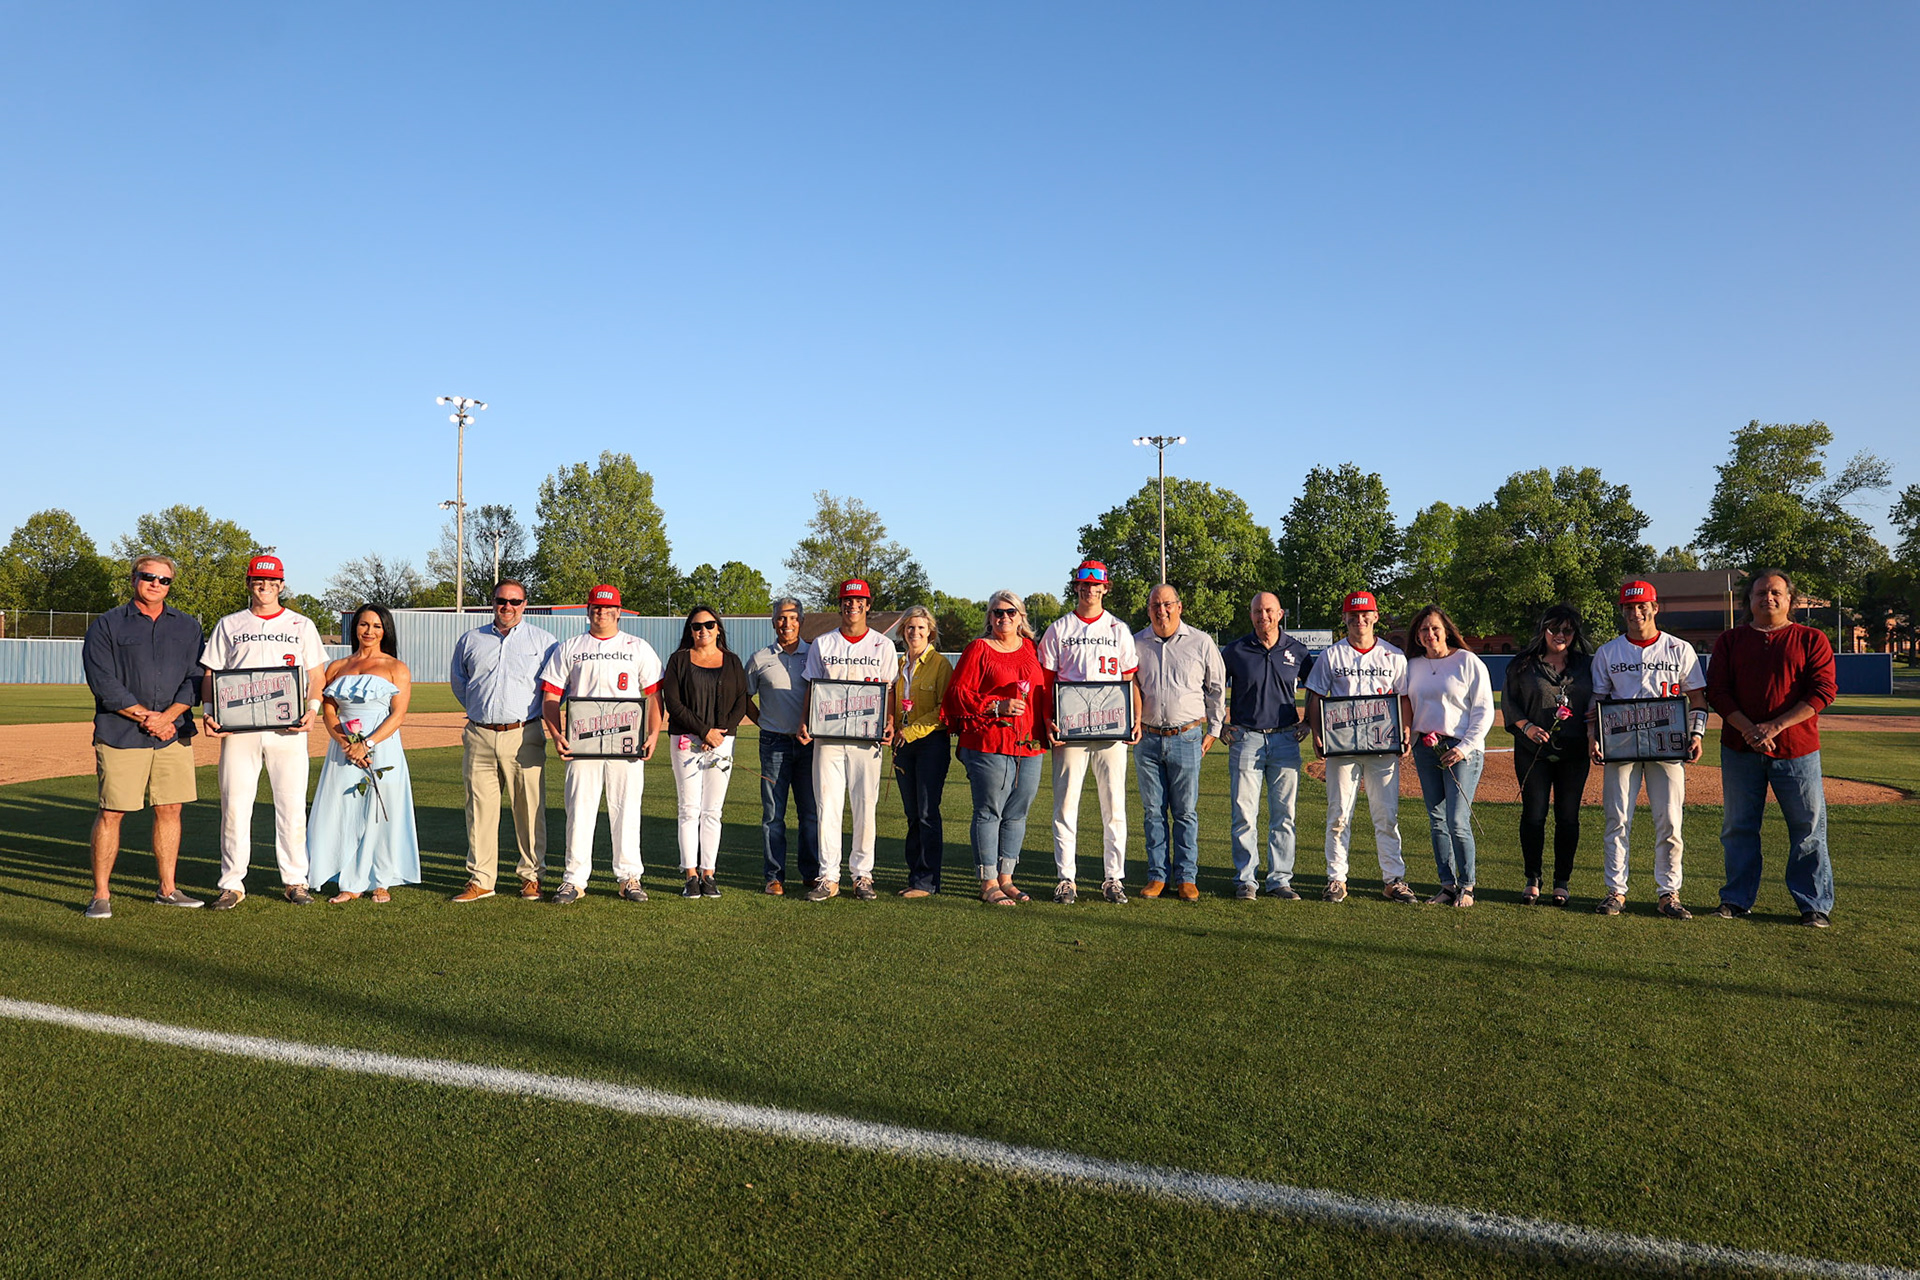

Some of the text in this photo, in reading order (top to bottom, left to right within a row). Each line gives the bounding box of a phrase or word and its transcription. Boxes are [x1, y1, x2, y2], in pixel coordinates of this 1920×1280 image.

[256, 562, 276, 570] SBA
[1625, 587, 1644, 596] SBA
[1099, 655, 1119, 675] 13
[617, 672, 629, 691] 8
[242, 693, 272, 705] EAGLES
[275, 701, 292, 722] 3
[838, 710, 864, 719] EAGLES
[1345, 717, 1373, 727] EAGLES
[1626, 721, 1656, 732] EAGLES
[592, 727, 620, 737] EAGLES
[1081, 724, 1108, 734] EAGLES
[1372, 725, 1399, 746] 14
[621, 735, 635, 754] 8
[1655, 731, 1686, 753] 19
